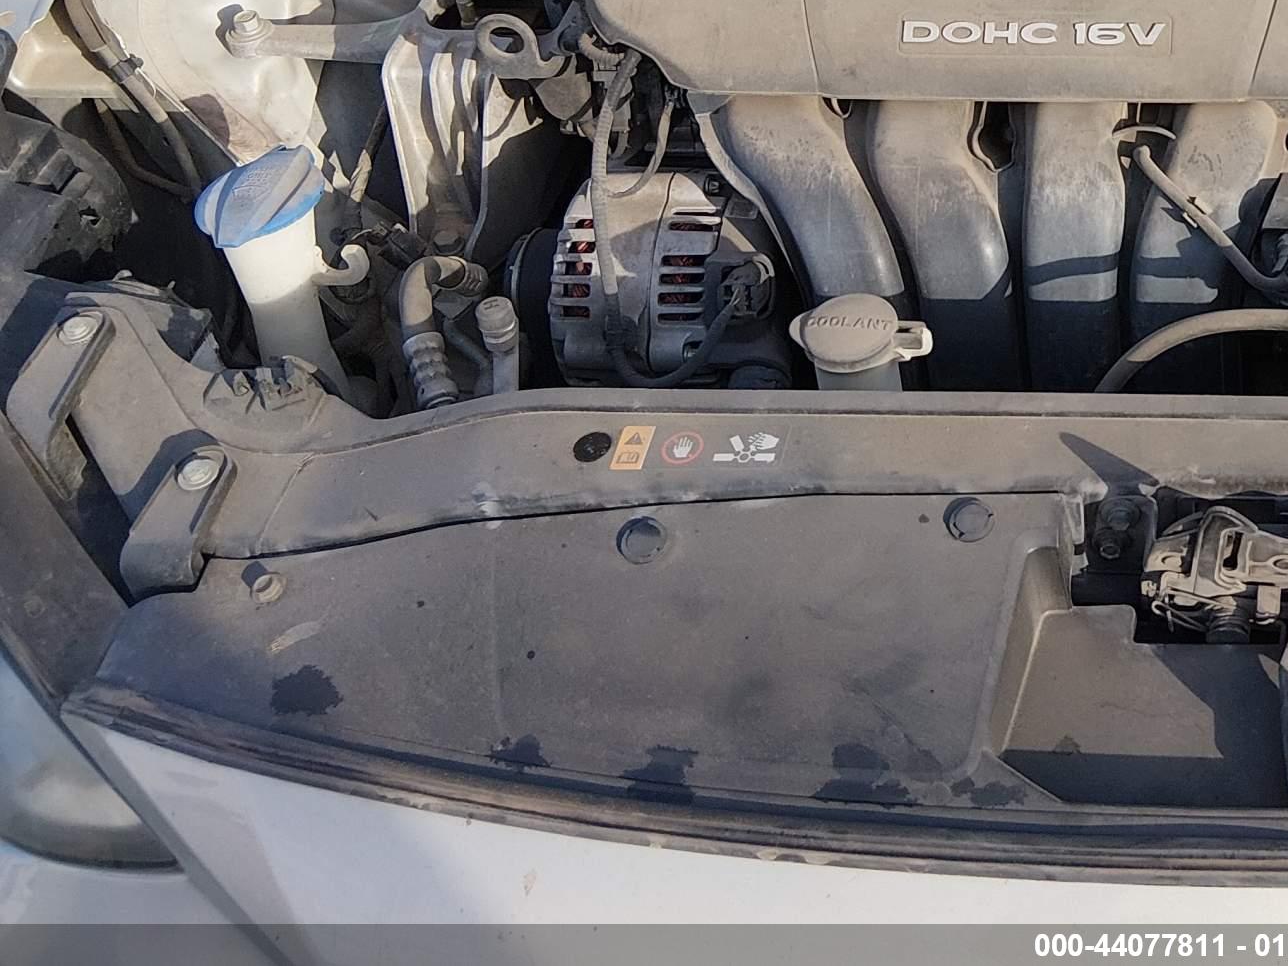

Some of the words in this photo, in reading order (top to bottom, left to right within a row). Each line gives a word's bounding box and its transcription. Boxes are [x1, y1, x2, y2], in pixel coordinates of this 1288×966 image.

[901, 21, 1058, 45] DOHC
[1073, 21, 1166, 47] 16V
[806, 315, 893, 331] COOLANT
